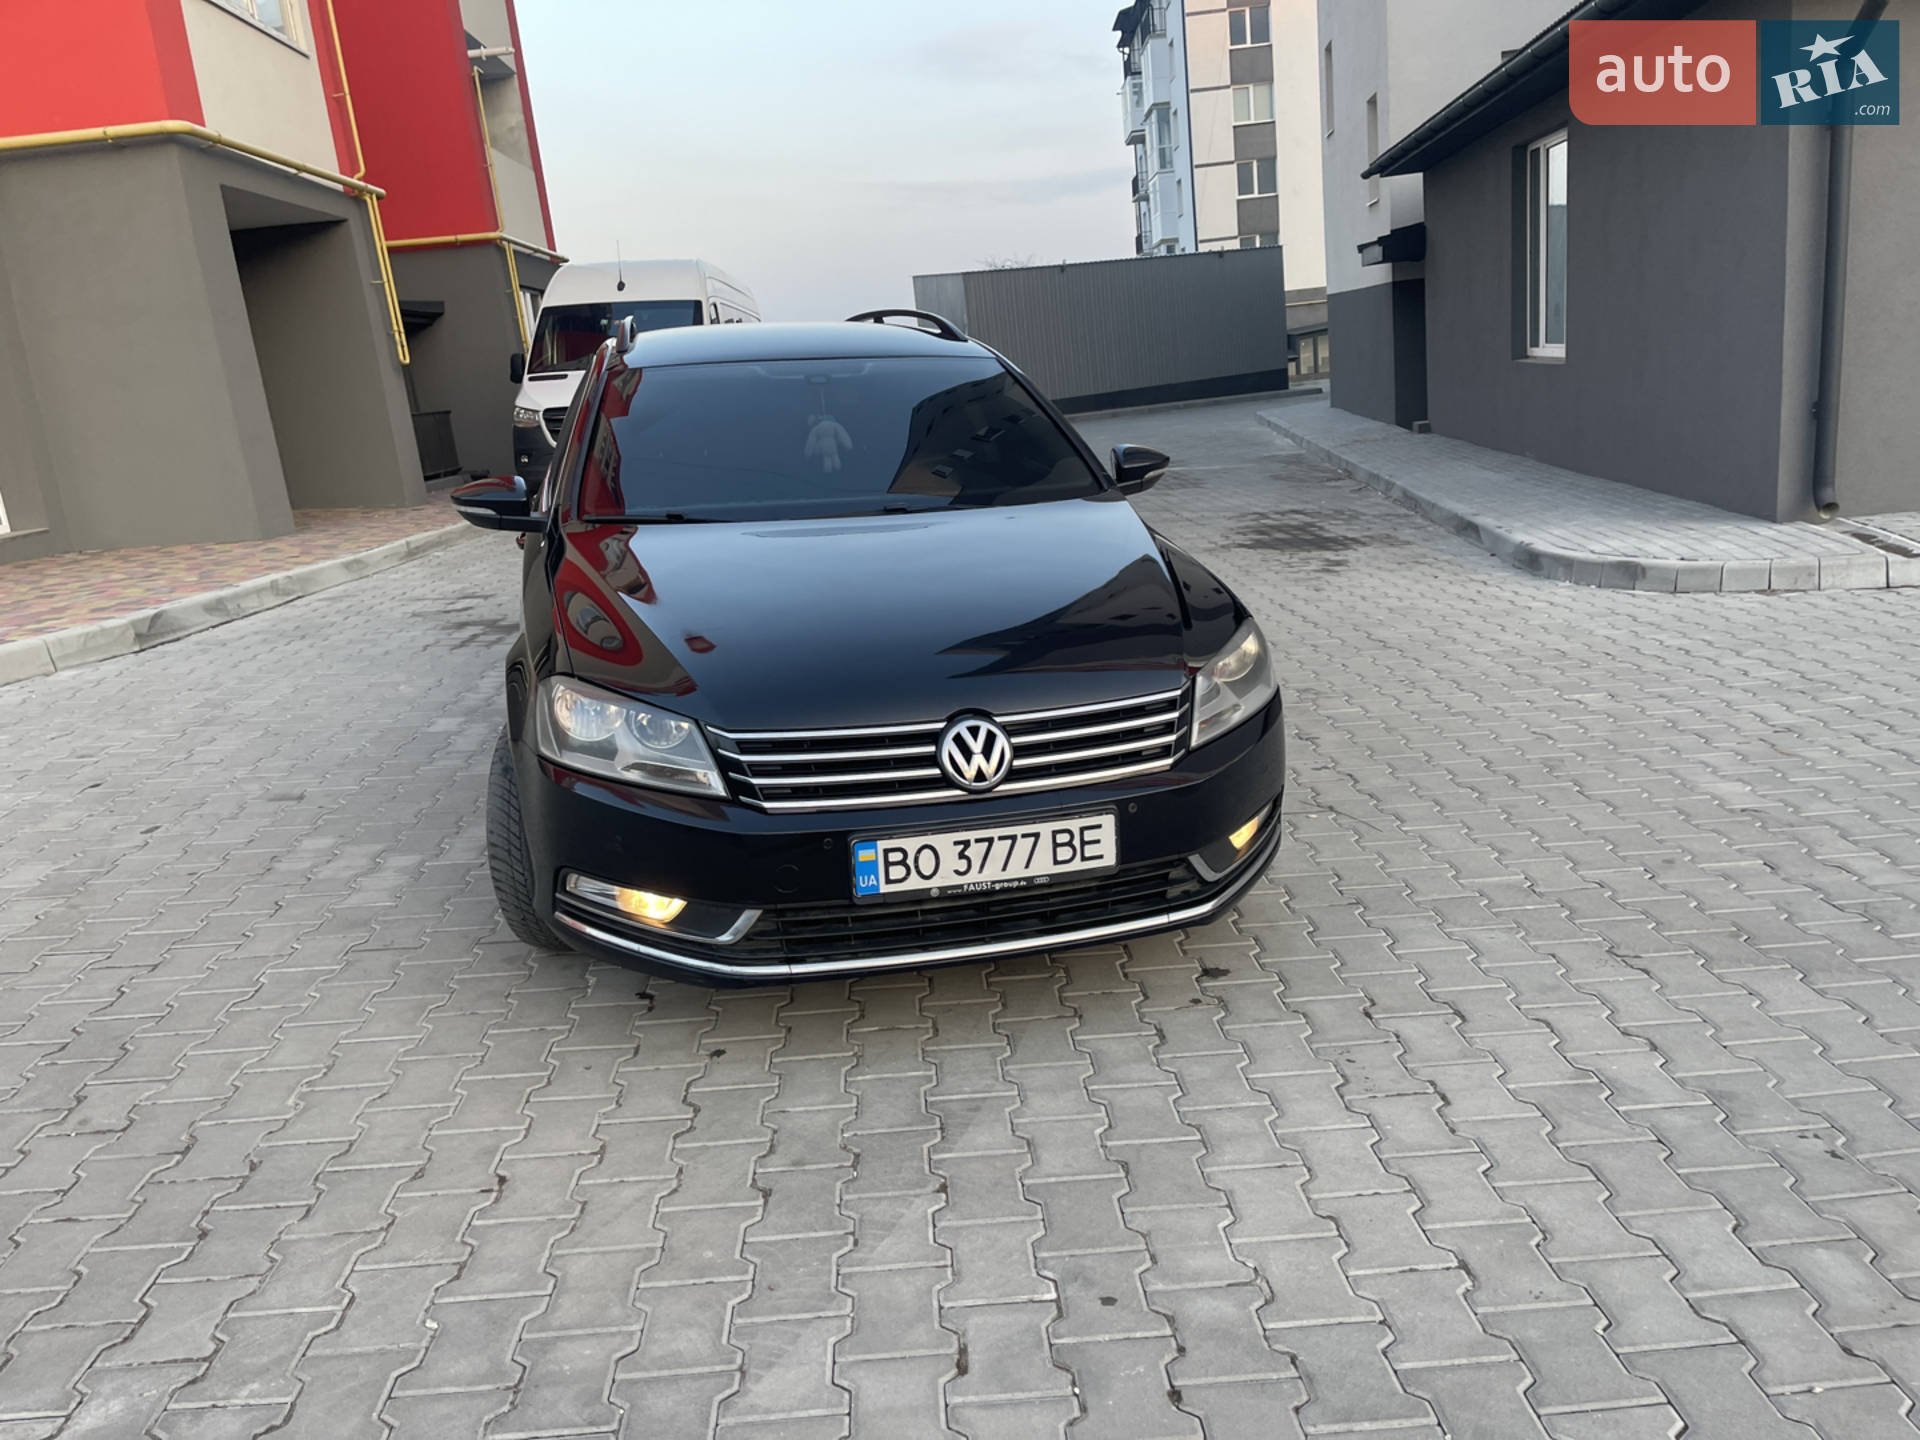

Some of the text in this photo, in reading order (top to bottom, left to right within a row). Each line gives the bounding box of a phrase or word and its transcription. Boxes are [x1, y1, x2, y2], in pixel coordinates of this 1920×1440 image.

[882, 824, 1104, 885] BO 3777 BE
[859, 874, 878, 888] UA
